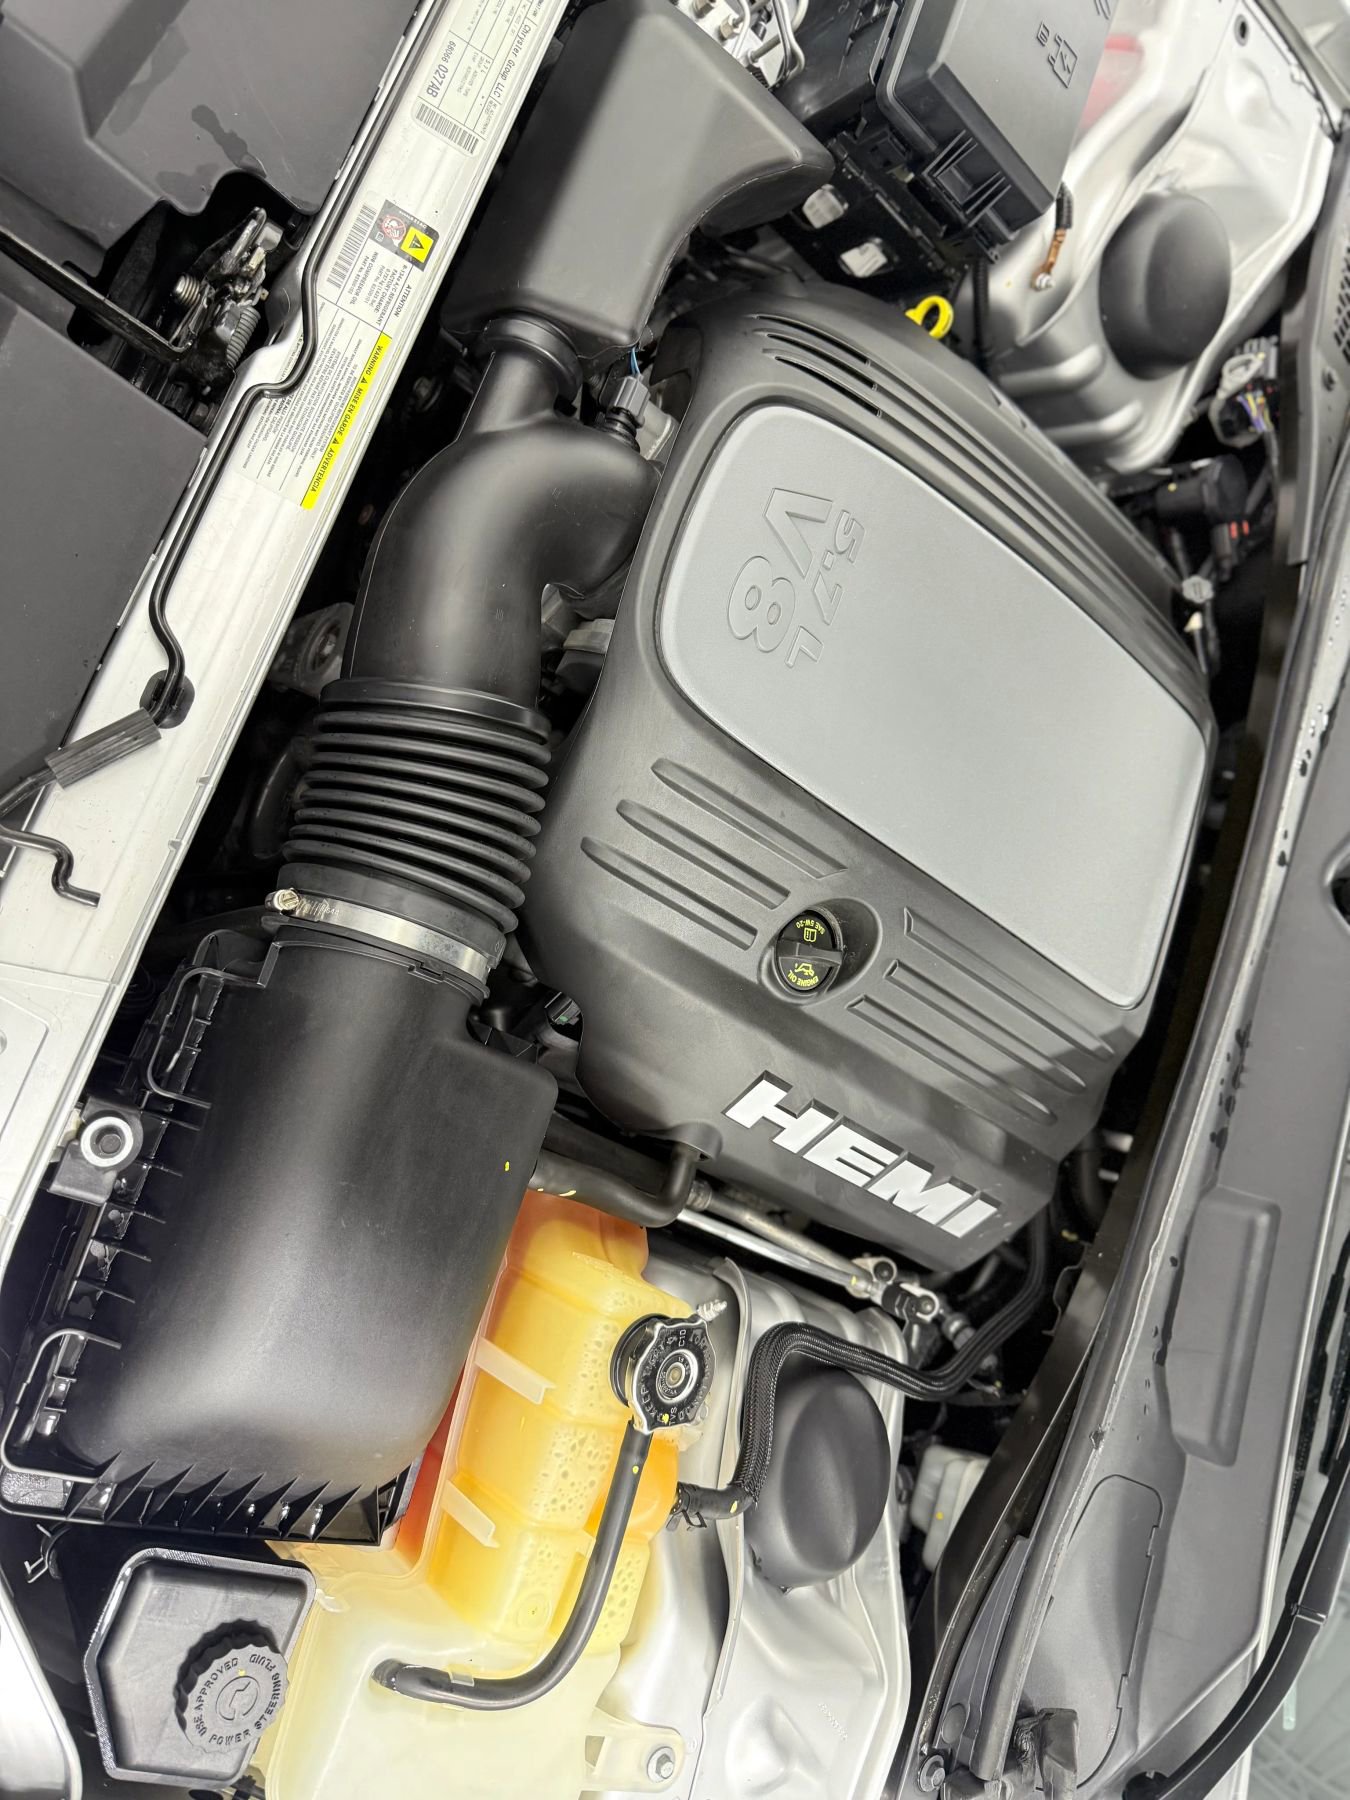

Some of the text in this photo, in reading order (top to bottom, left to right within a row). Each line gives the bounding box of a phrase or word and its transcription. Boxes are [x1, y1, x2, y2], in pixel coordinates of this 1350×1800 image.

[510, 23, 531, 57] Chrysler
[425, 40, 456, 98] 68066 027AB
[498, 57, 515, 81] Group
[493, 82, 504, 97] LLC
[384, 268, 397, 291] FACTORY
[375, 291, 394, 325] REFRIGERANT
[393, 283, 412, 317] ATTENTION
[309, 344, 383, 492] WARNING MISE EN GARDE ADVERTENCIA
[727, 486, 834, 654] V8
[796, 919, 826, 935] SAE 5W-20
[787, 969, 819, 987] ENGINE OIL
[724, 1071, 1004, 1238] HEMI
[193, 1653, 281, 1746] USE APPROVED POWER STEERING FLUID
